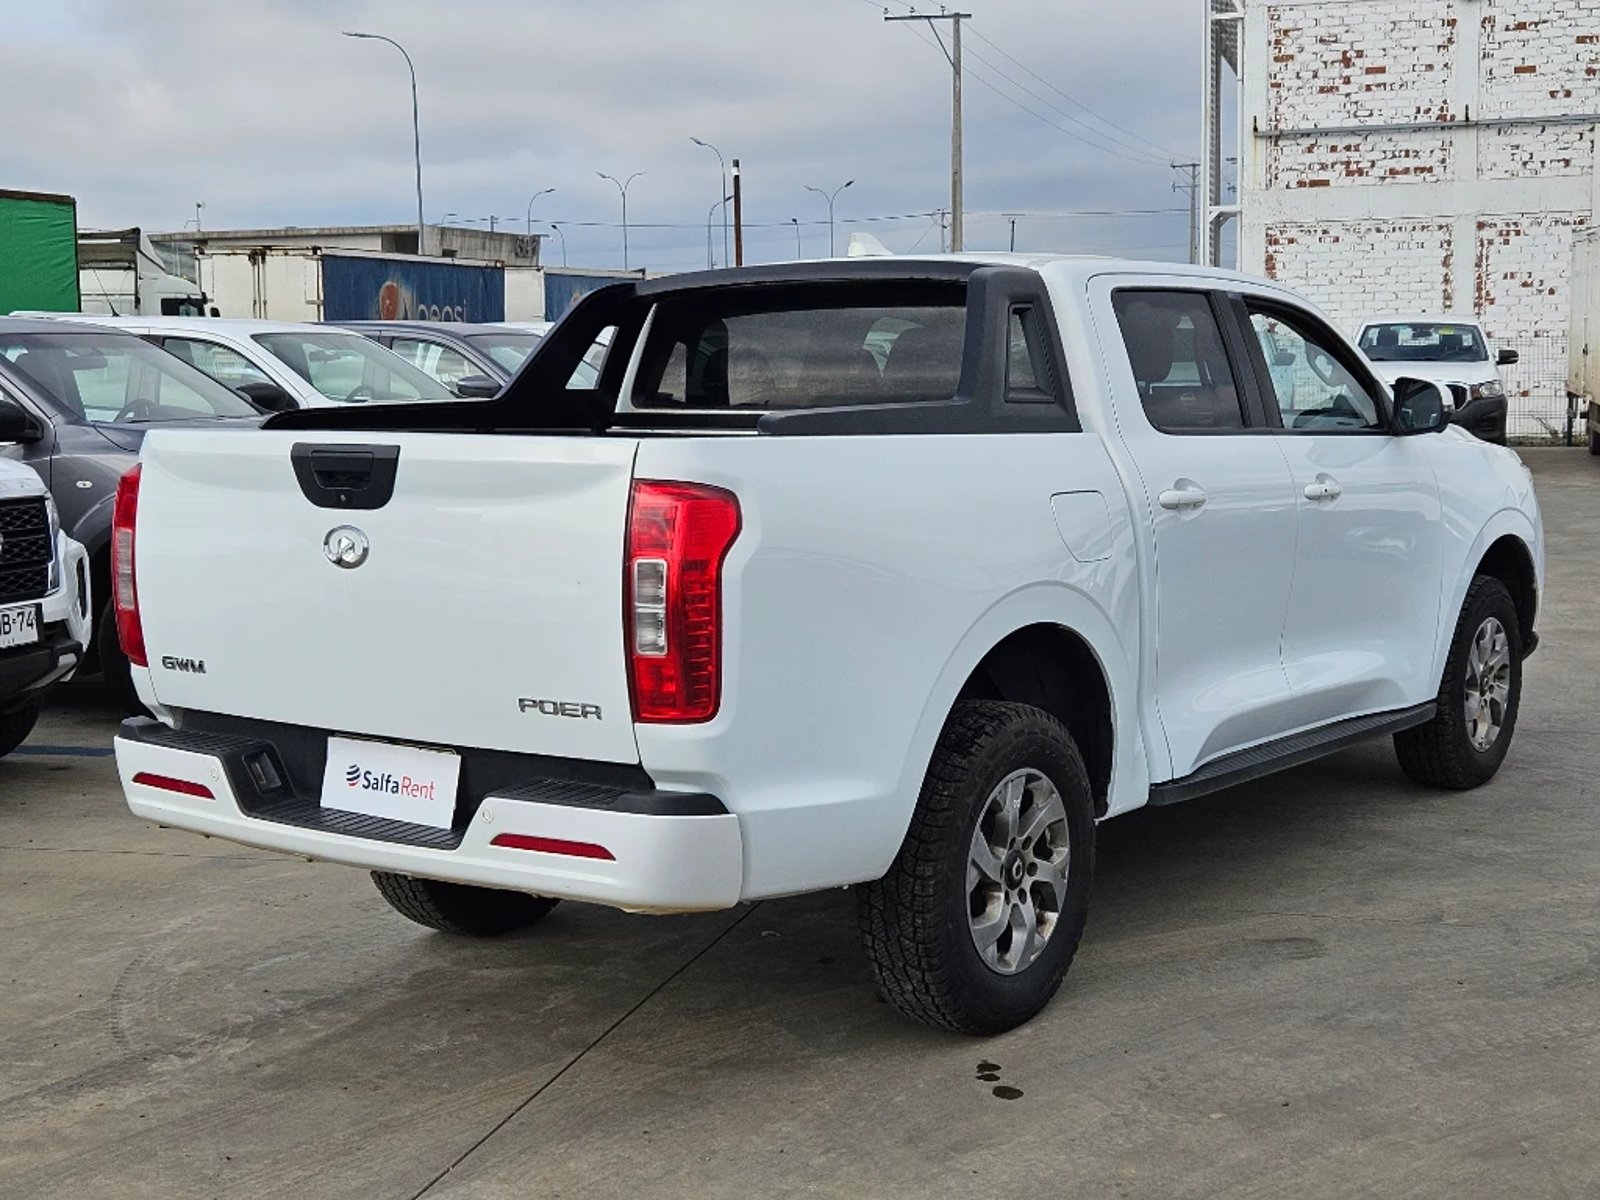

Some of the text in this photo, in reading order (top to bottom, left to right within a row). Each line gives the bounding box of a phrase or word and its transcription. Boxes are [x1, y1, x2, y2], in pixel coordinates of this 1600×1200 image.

[0, 611, 33, 635] B-74
[162, 655, 206, 674] GWM
[518, 698, 602, 720] POER
[362, 770, 435, 800] SalfaRent
